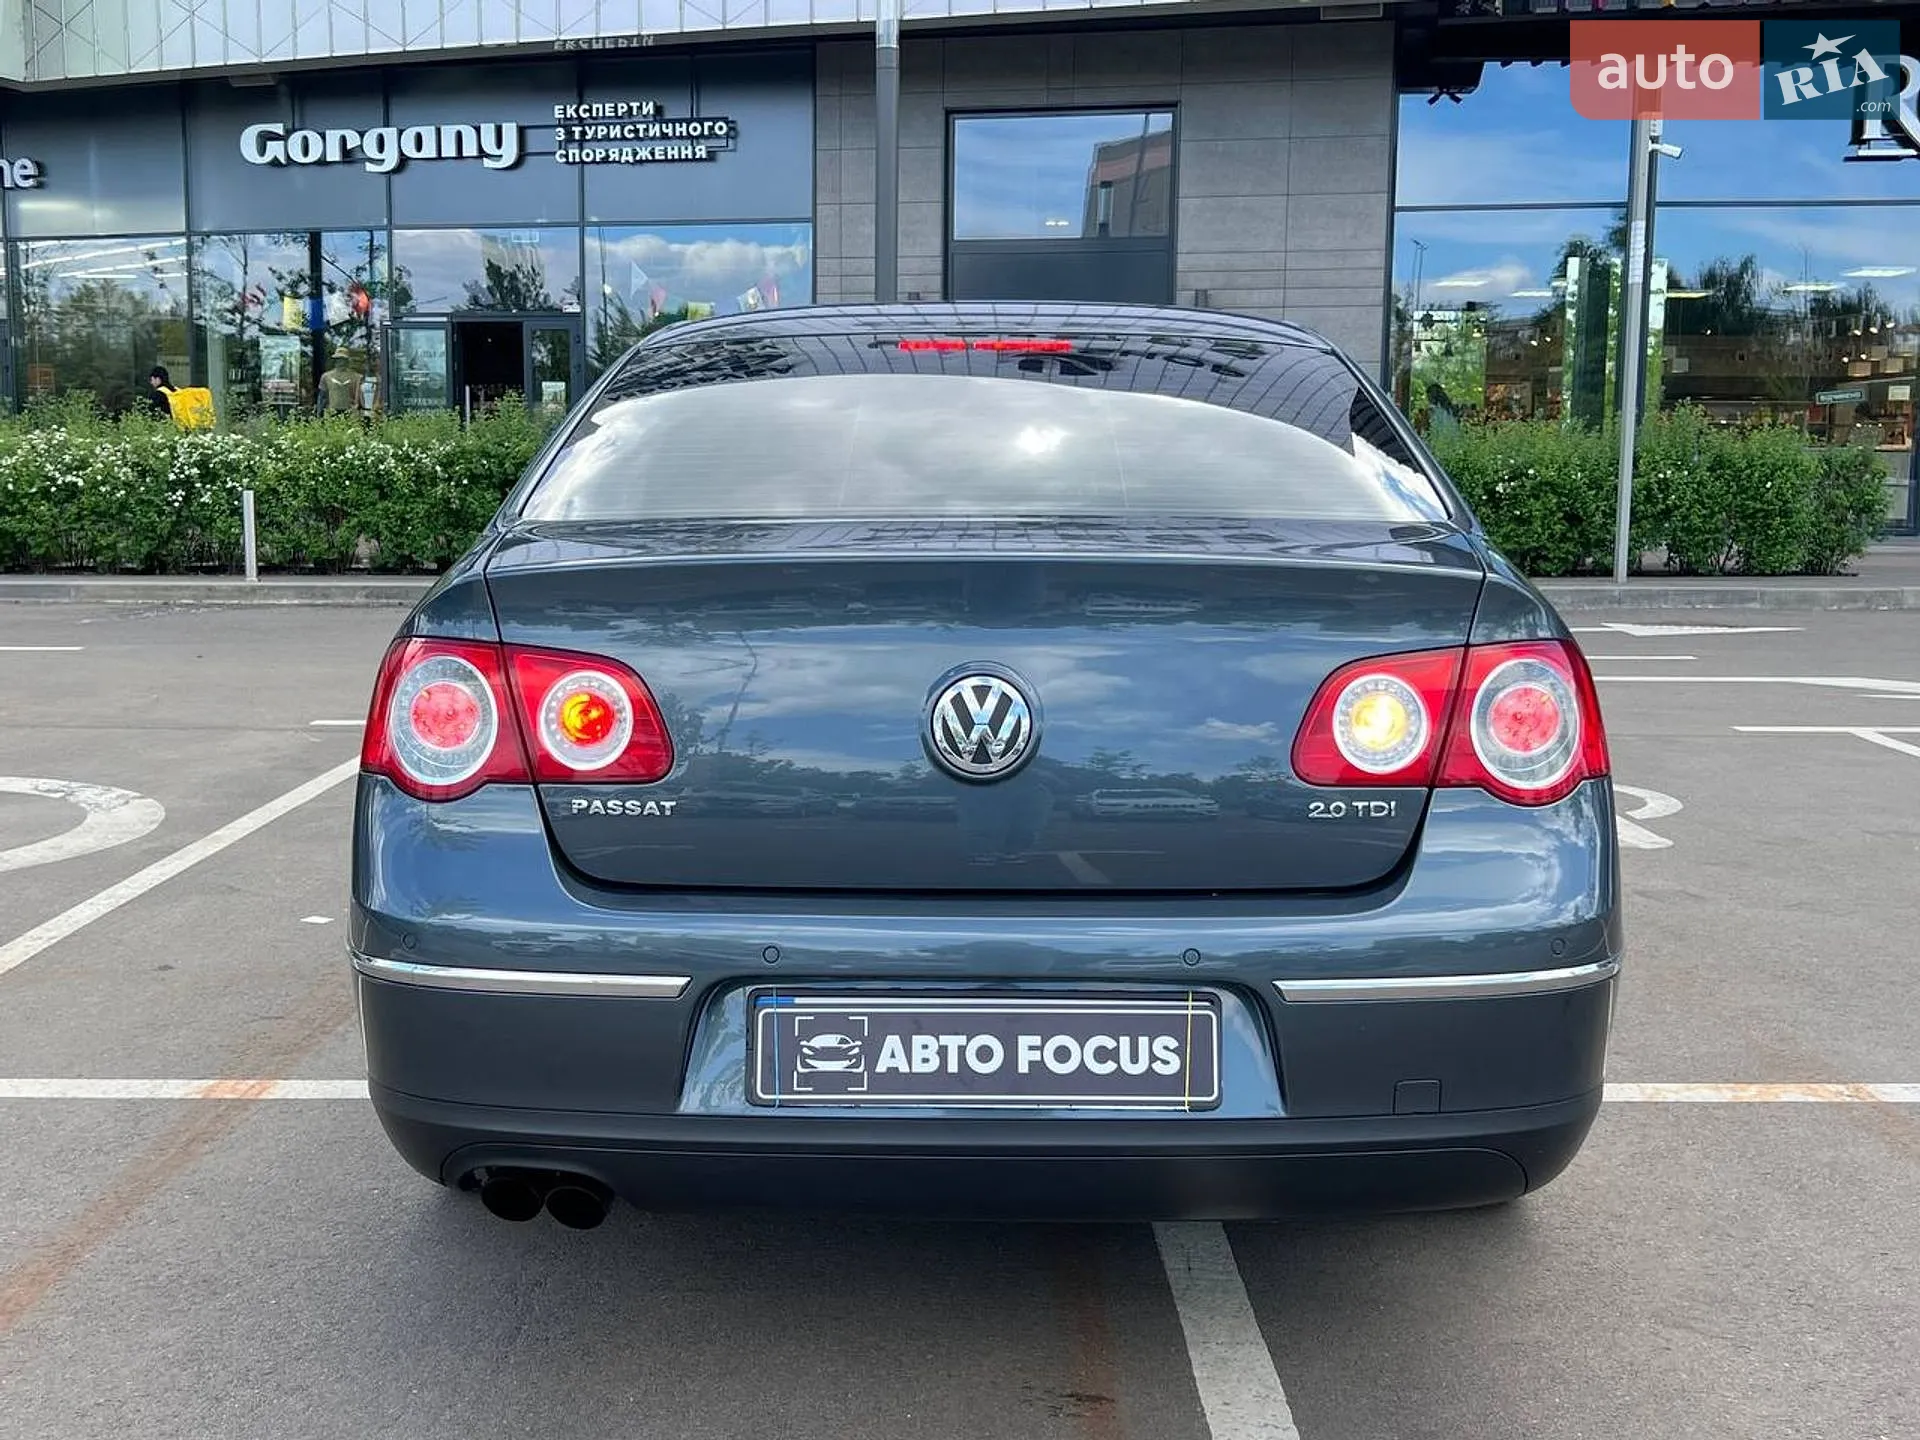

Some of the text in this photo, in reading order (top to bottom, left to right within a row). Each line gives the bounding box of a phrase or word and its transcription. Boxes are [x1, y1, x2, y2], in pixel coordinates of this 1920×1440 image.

[554, 102, 654, 119] ЕКСПЕРТИ
[572, 121, 728, 140] ТУРИСТИЧНОГО
[240, 122, 519, 172] Gorgany
[555, 146, 708, 163] СПОРЯДЖЕННЯ
[571, 799, 676, 816] PASSAT
[1351, 800, 1397, 818] TDI
[1017, 1034, 1182, 1076] FOCUS
